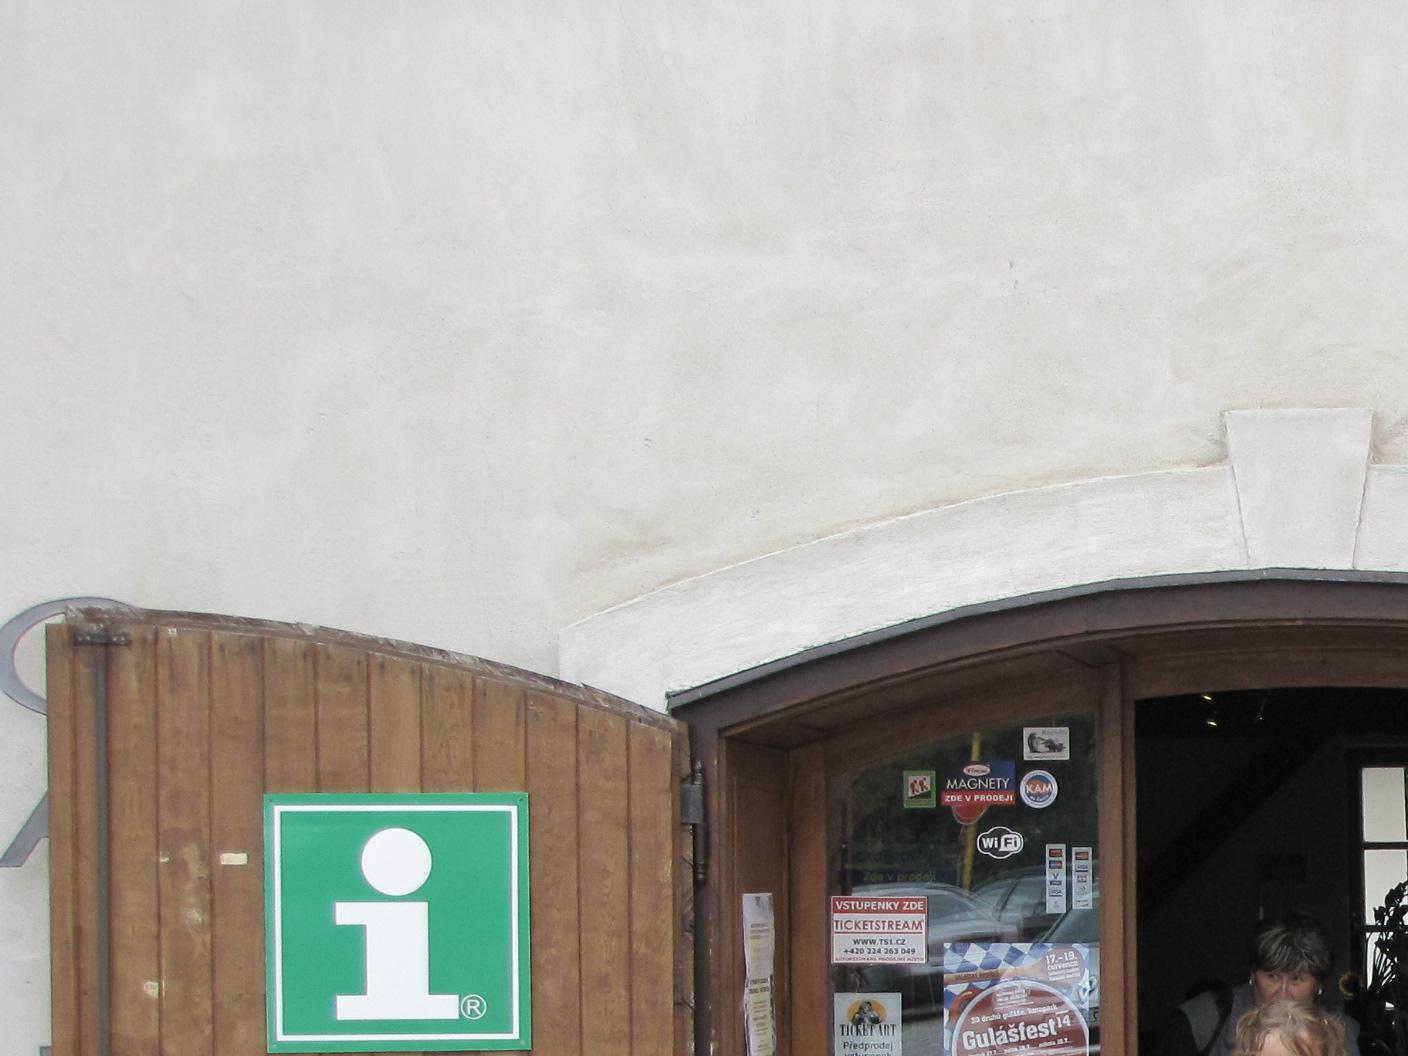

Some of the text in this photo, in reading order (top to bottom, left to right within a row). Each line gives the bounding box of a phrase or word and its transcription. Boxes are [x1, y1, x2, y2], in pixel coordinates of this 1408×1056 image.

[946, 777, 1010, 790] MAGNETY
[1025, 783, 1053, 793] KAM
[945, 794, 1013, 802] ZDE V PRODEJI
[864, 871, 885, 881] Zde
[835, 900, 924, 911] VSTUPENKY ZDE
[834, 919, 923, 931] TICKETSTREAM
[852, 938, 906, 946] WWW.TS1.CZ
[843, 947, 916, 955] +420 224 263 049
[840, 1024, 897, 1037] TICKET ART
[962, 1018, 1058, 1051] Gulášfest
[843, 1040, 893, 1052] Předprodej
